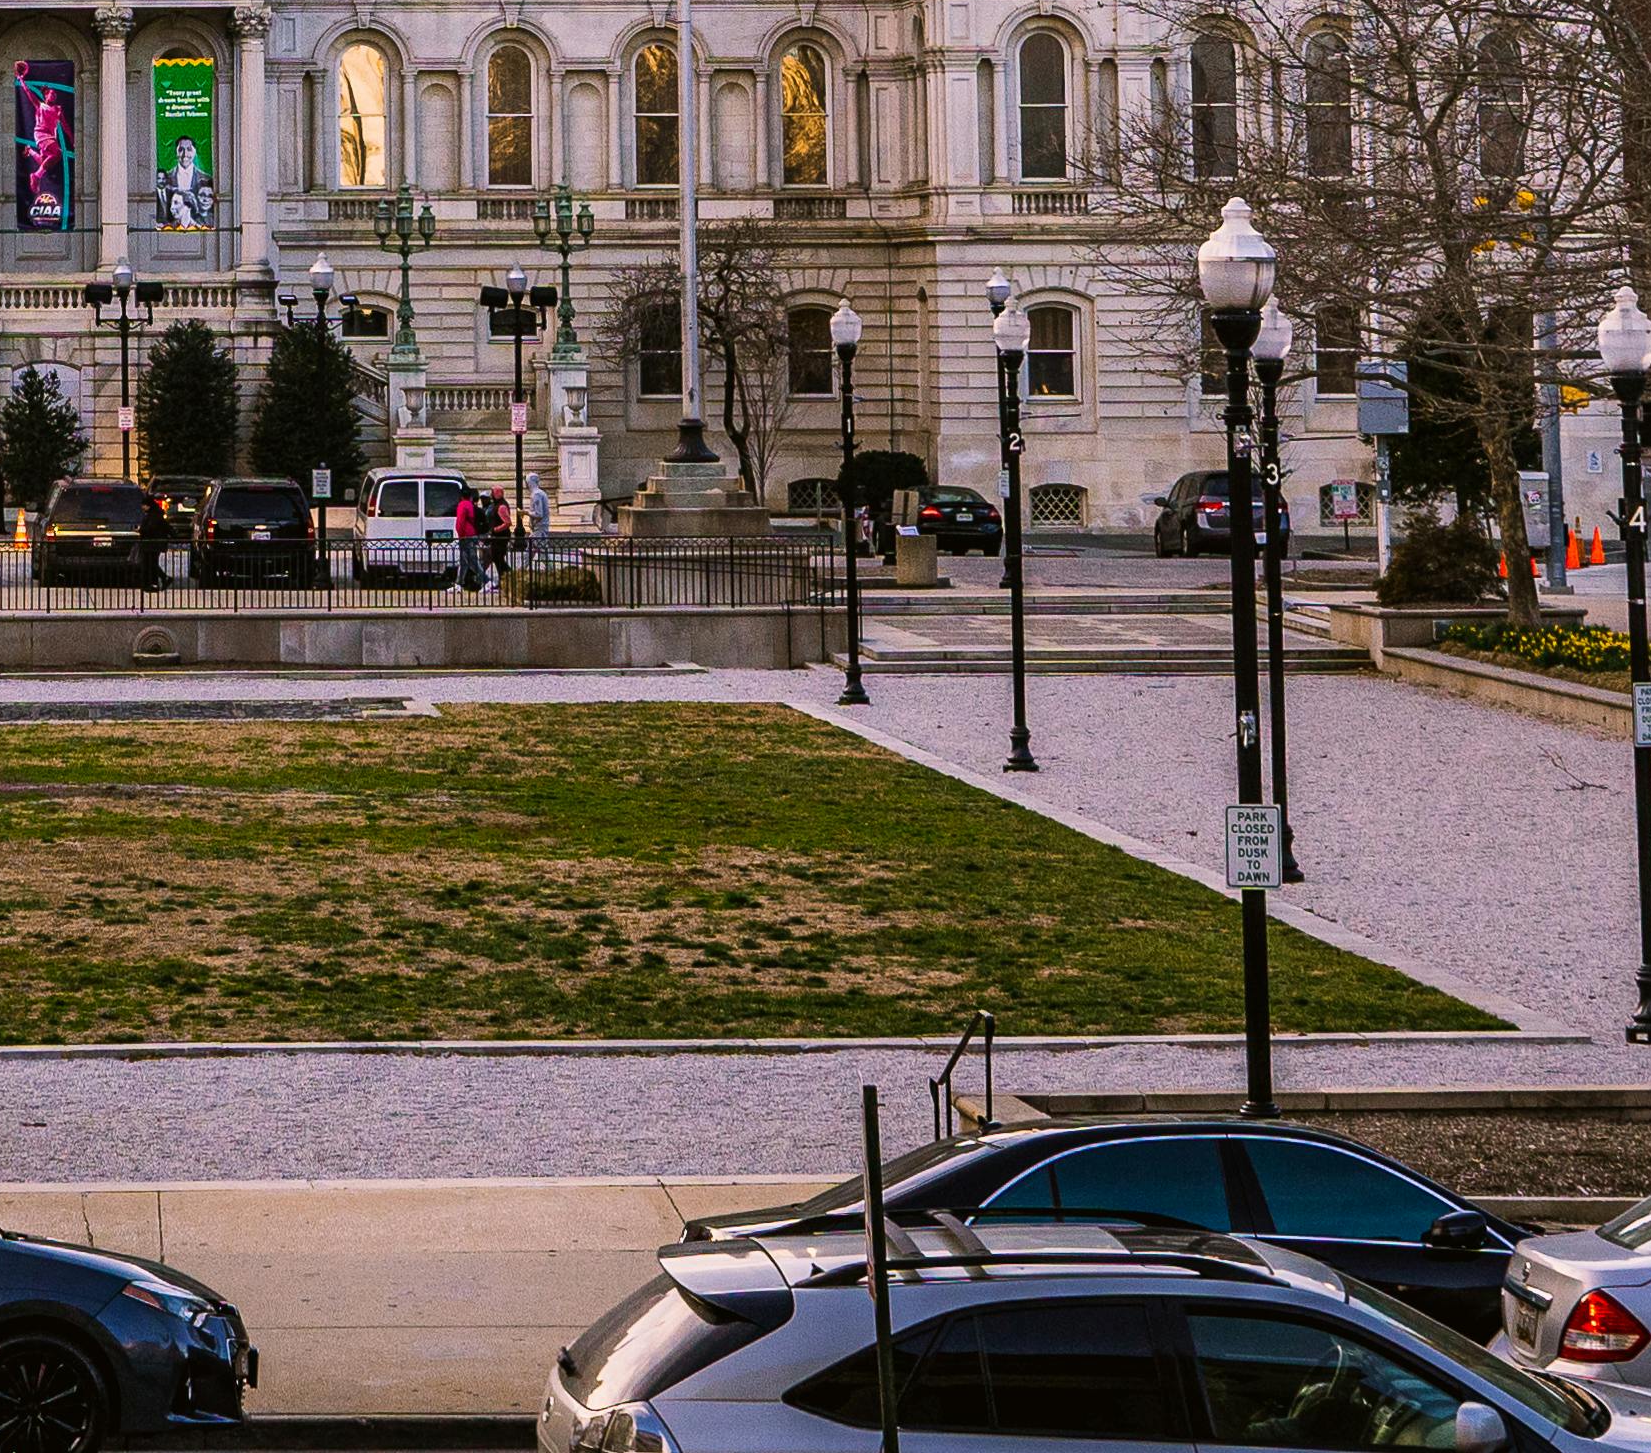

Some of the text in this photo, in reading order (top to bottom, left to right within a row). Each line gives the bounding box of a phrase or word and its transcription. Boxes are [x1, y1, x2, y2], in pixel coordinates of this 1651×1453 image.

[29, 205, 61, 216] CIAA
[1009, 433, 1020, 450] 2
[1266, 463, 1279, 485] 3
[1629, 505, 1647, 533] 4
[1237, 812, 1268, 822] PARK
[1231, 824, 1275, 834] CLOSED
[1237, 836, 1269, 846] FROM
[1238, 848, 1268, 858] DUSK
[1247, 860, 1261, 870] TO
[1238, 872, 1270, 883] DAWN
